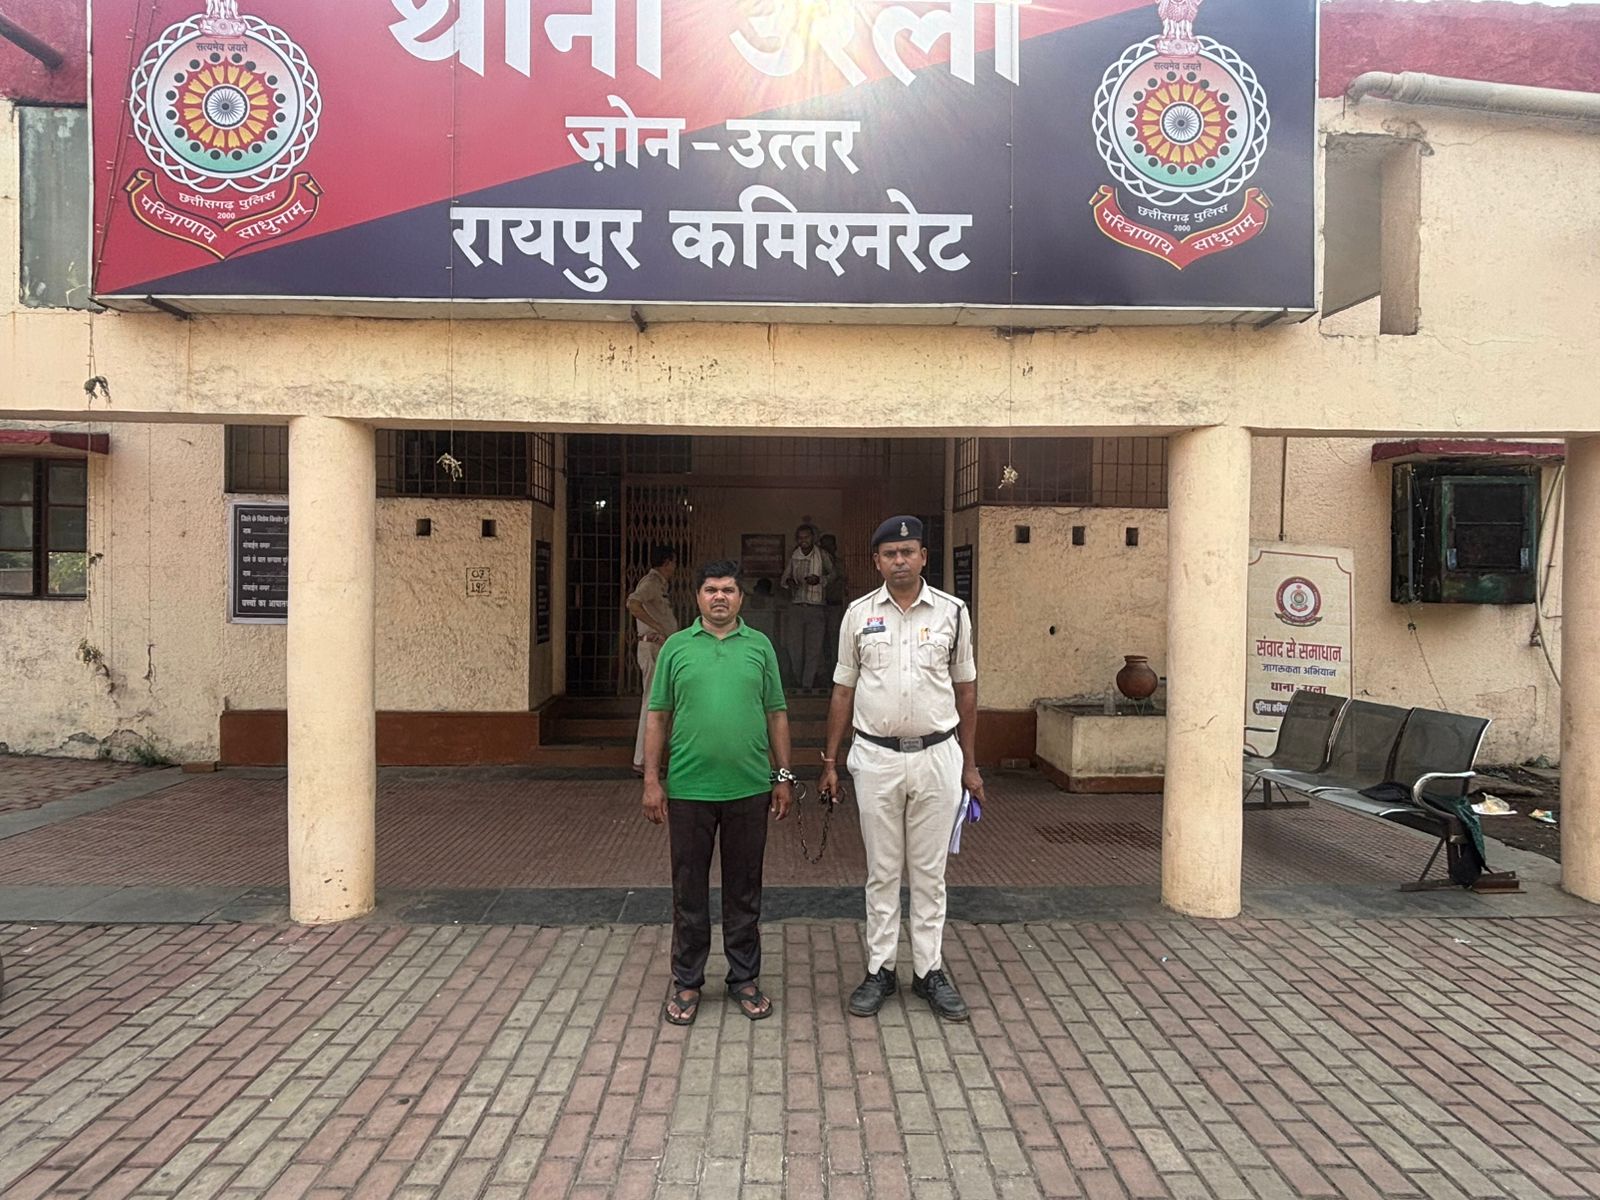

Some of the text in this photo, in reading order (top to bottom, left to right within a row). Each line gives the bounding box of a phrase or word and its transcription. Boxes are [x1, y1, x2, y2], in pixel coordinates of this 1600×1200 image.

[196, 40, 248, 52] सत्यमेव जयते
[387, 0, 662, 79] थाना
[178, 190, 276, 211] छत्तीसगढ़ पुलिस
[141, 194, 218, 243] परित्राणाय
[217, 212, 236, 220] 2000
[1137, 204, 1229, 223] छत्तीसगढ़ पुलिस
[1102, 208, 1174, 255] परित्राणाय
[1173, 224, 1191, 232] 2000
[450, 184, 973, 293] रायपुर कमिश्नरेट
[1256, 636, 1342, 662] संवाद से समाधान
[1303, 665, 1337, 677] अभियान
[1271, 682, 1294, 693] थाना
